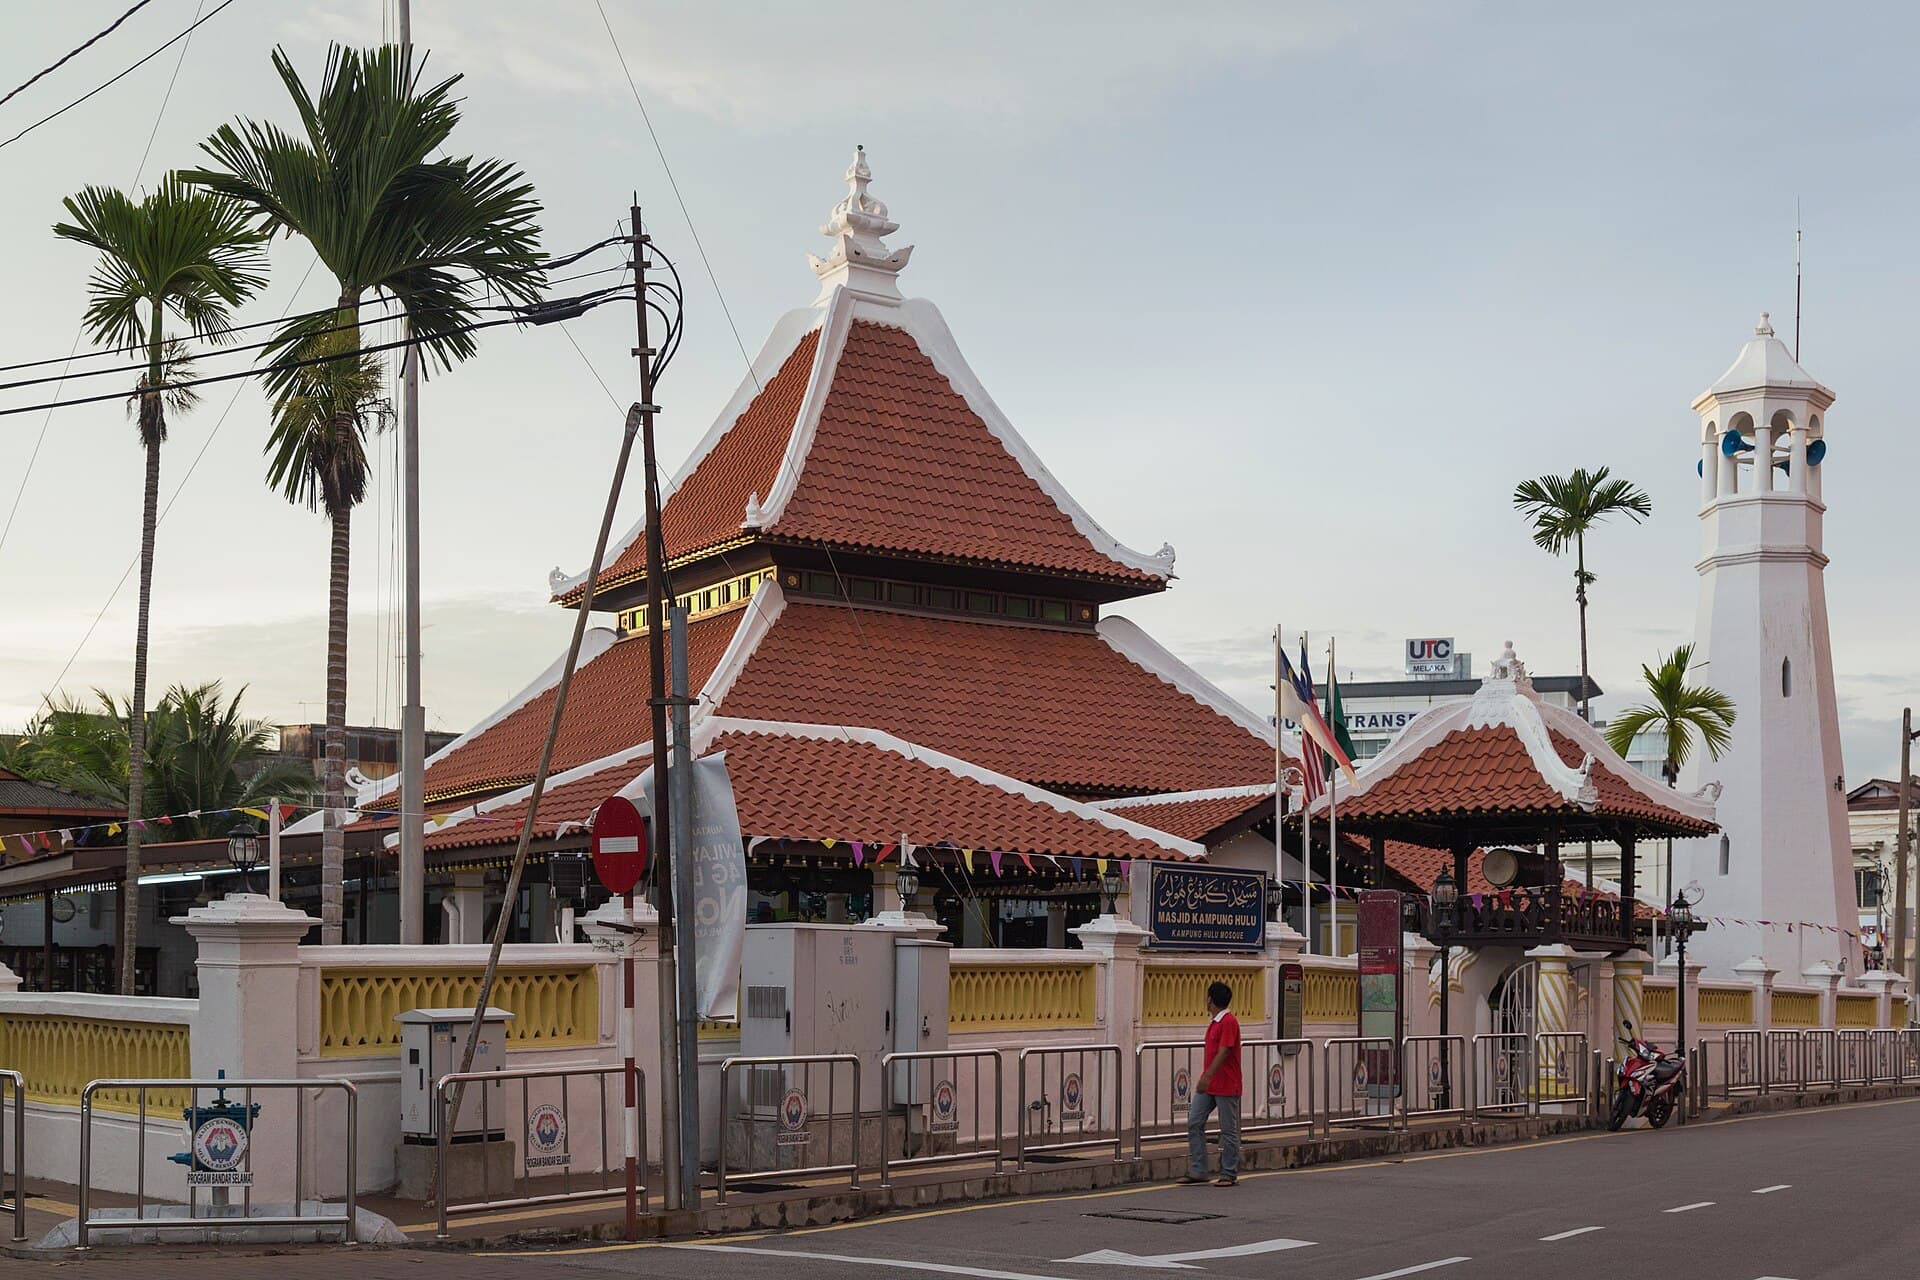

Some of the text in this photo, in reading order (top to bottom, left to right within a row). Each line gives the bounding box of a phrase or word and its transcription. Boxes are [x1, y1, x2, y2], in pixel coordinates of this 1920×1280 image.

[1410, 640, 1450, 659] UTC
[1413, 664, 1446, 672] MELAKA
[1158, 912, 1257, 927] MASJID KAMPUNG HULU
[1171, 929, 1244, 940] KAMPUNG HULU MOSQUE
[187, 1173, 254, 1184] PROGRAM BANDAR SELAMAT
